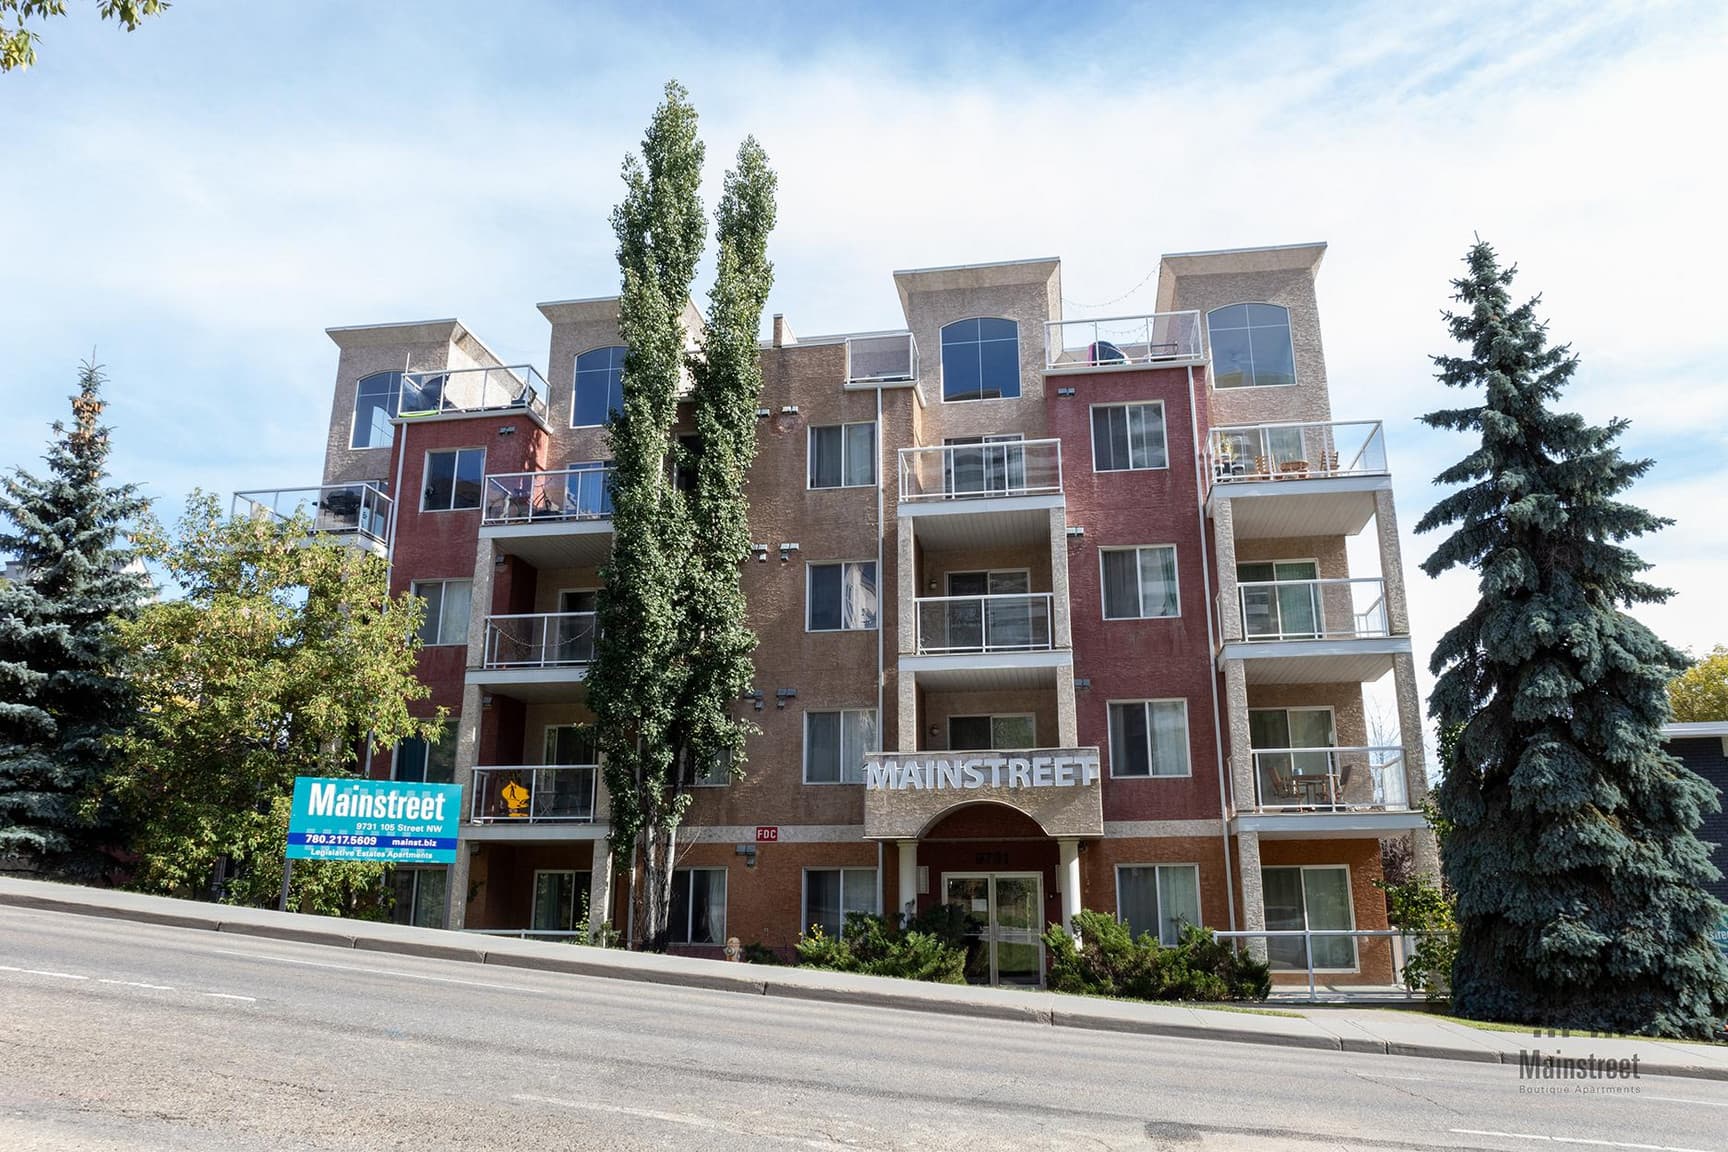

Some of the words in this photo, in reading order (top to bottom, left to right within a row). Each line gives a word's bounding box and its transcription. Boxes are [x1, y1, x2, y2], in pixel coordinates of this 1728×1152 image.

[866, 755, 1099, 790] MAINSTREET
[308, 782, 446, 821] Mainstreet
[356, 822, 377, 831] 9731
[381, 823, 395, 832] 105
[397, 823, 424, 833] Street
[426, 825, 443, 833] NW
[305, 834, 377, 846] 780.217.5609
[392, 838, 437, 847] mainst.biz
[757, 829, 777, 840] FDC
[310, 848, 355, 858] Legislative
[356, 849, 386, 858] Estates
[386, 850, 433, 860] Apartments
